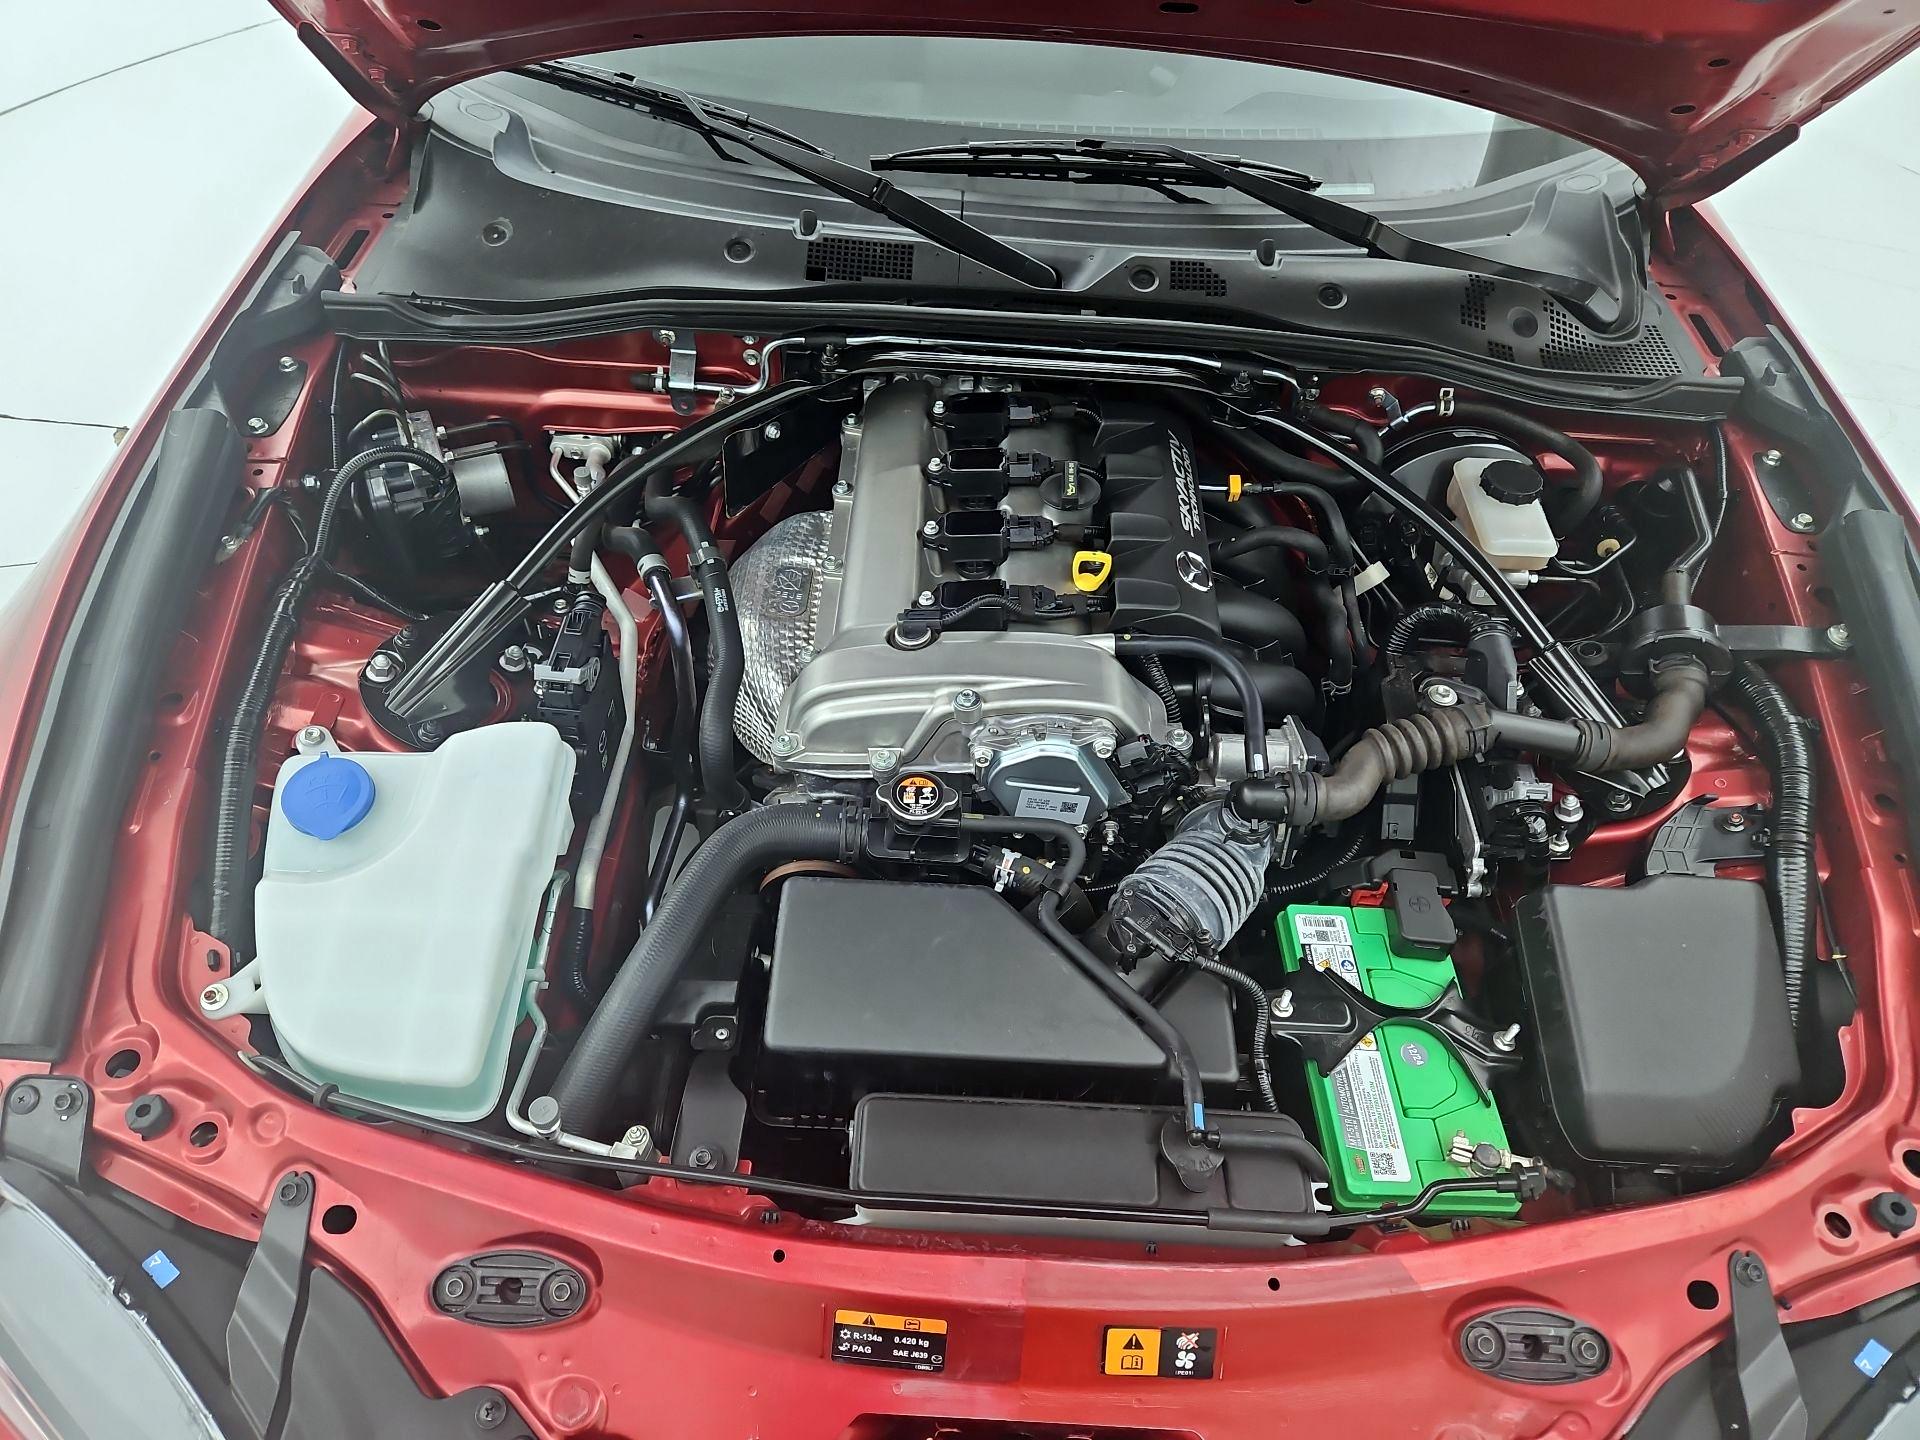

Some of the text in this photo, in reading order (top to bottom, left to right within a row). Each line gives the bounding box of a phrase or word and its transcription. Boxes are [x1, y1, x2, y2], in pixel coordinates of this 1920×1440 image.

[1167, 429, 1195, 537] SKYACTIV
[1180, 443, 1202, 532] TECHNOLOGY
[1406, 1043, 1425, 1066] 12/24
[1335, 1072, 1350, 1114] AUTOMOTIVE
[851, 1344, 929, 1359] PAG SAE J639
[853, 1331, 930, 1348] R-134a 0.420 kg
